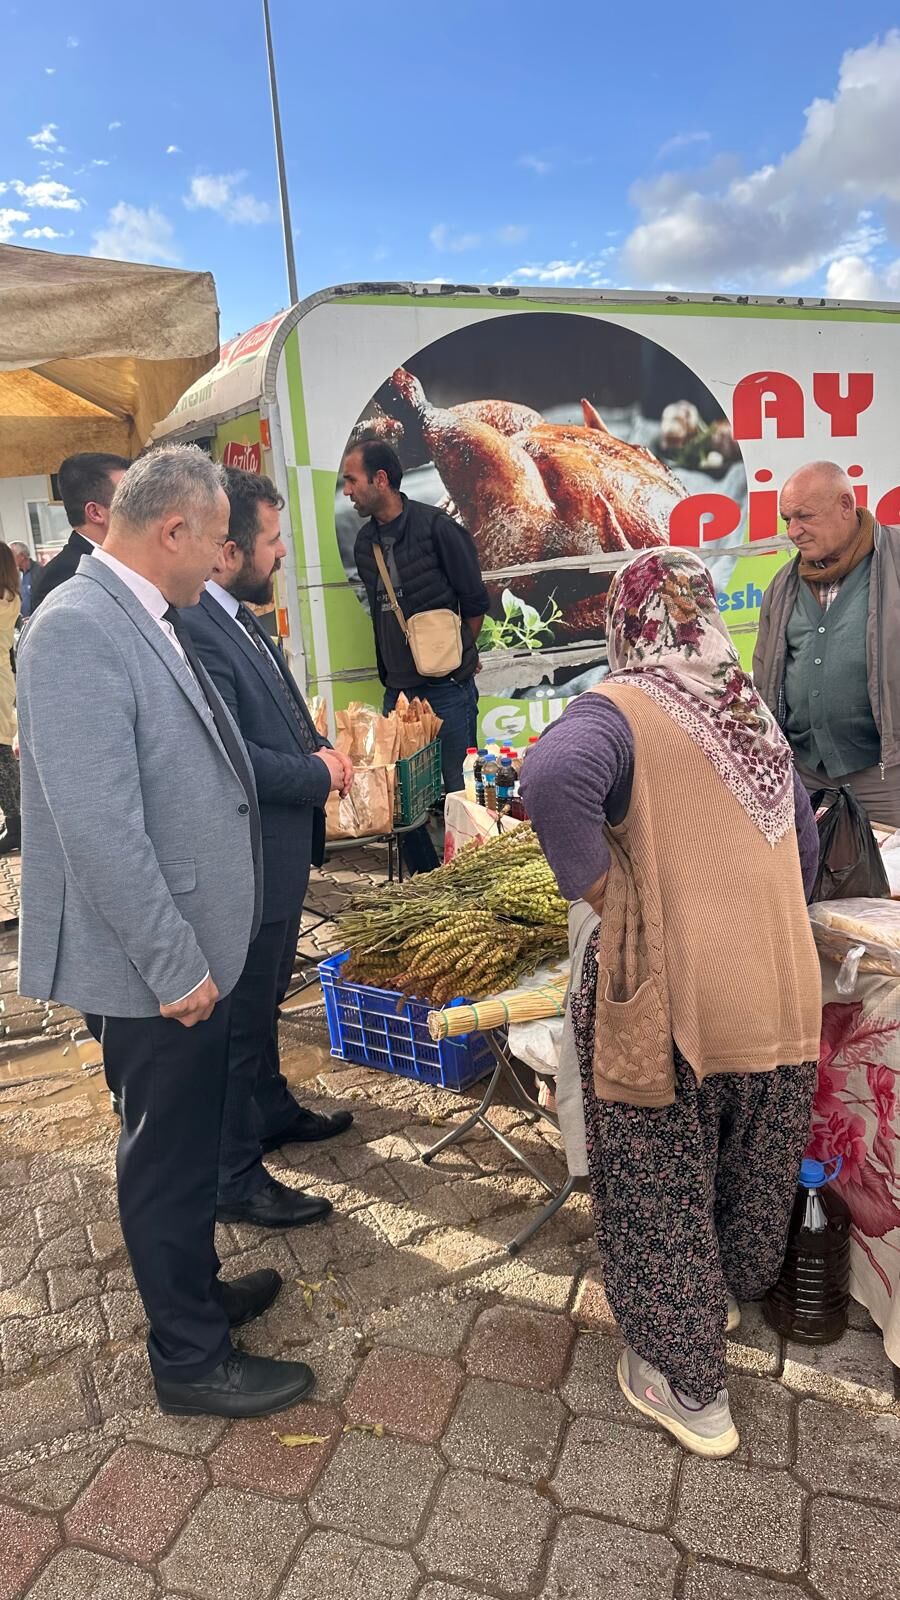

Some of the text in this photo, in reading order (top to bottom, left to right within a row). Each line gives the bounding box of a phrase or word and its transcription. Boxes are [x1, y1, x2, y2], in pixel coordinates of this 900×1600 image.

[733, 371, 874, 440] AY
[715, 582, 763, 612] esh
[481, 688, 580, 741] GÜ
